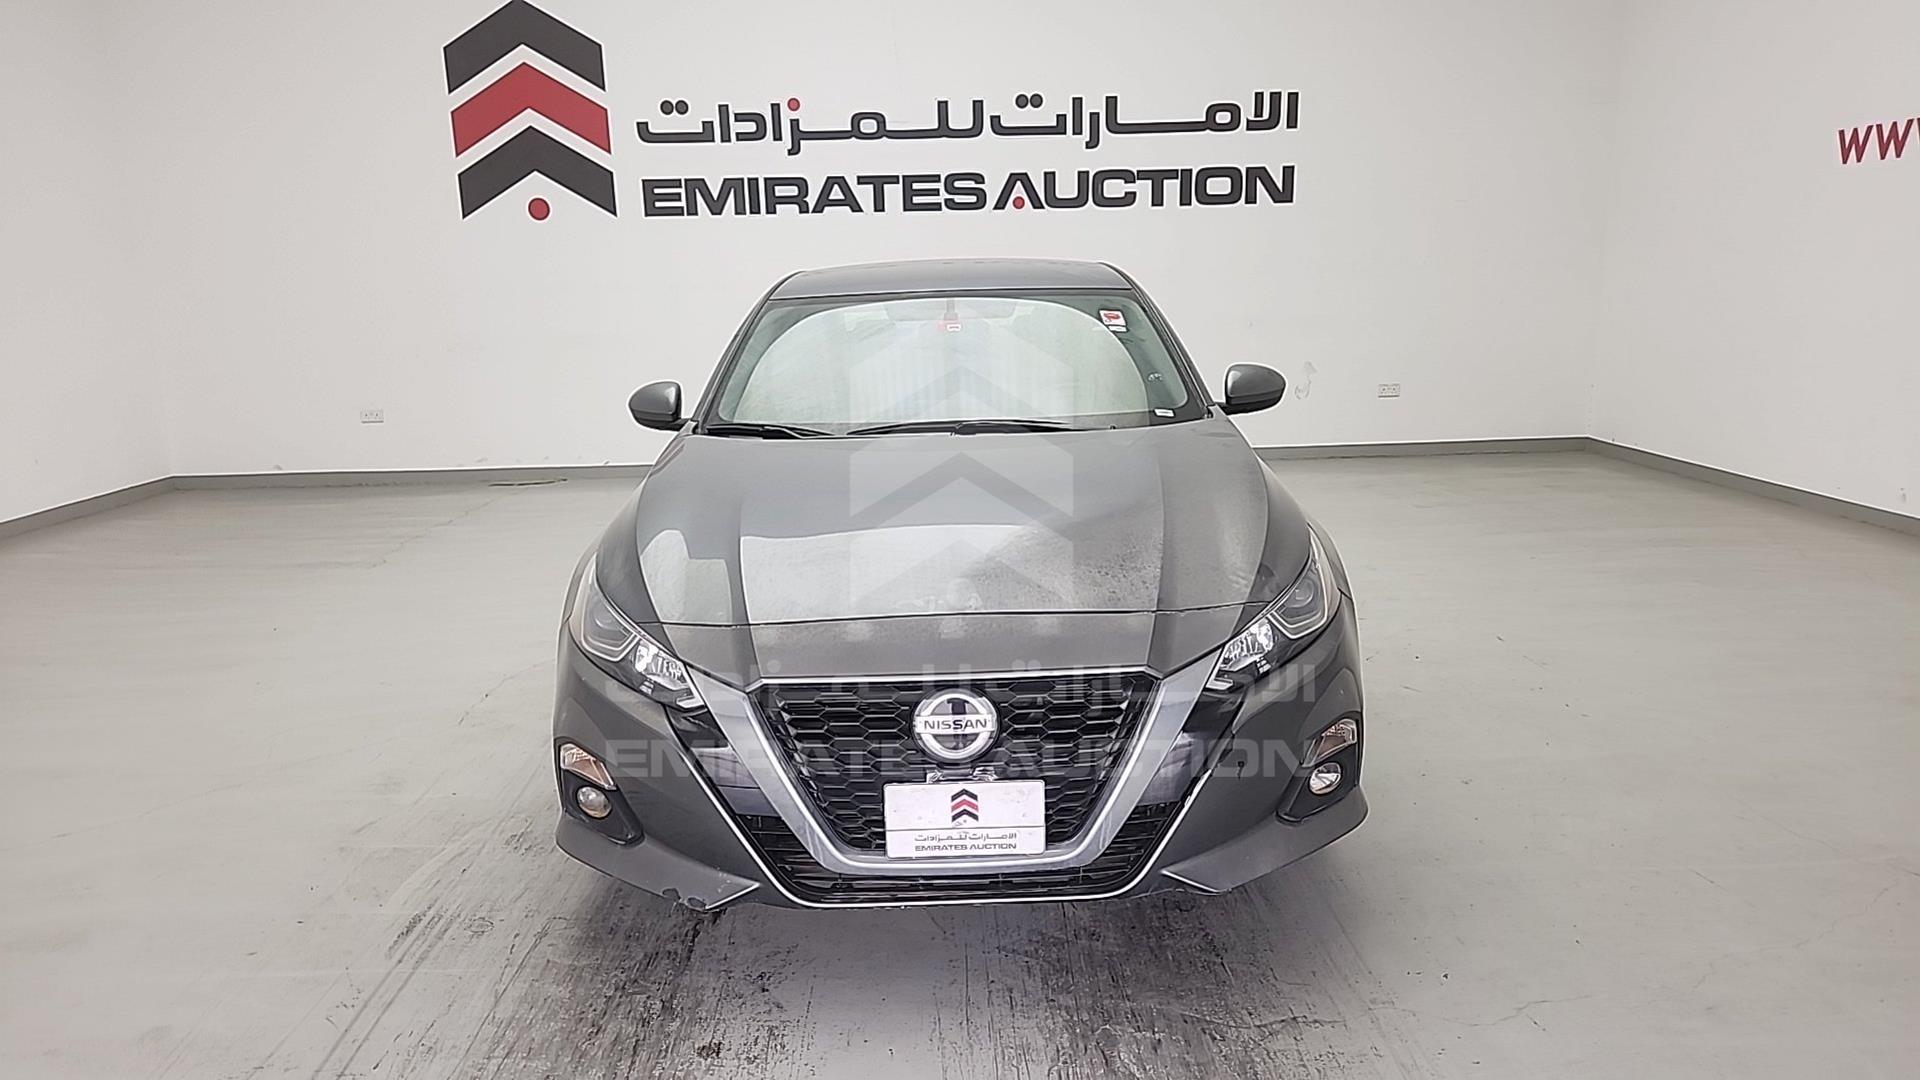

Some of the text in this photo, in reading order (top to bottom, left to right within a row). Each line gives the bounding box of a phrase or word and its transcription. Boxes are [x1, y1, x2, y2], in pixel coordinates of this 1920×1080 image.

[636, 91, 1298, 156] الامارات للمزادات
[642, 165, 1294, 217] EMIRATES AUCTION
[924, 718, 988, 731] NISSAN
[968, 831, 1017, 841] الامارات
[914, 842, 1017, 852] EMIRATES AUCTION
